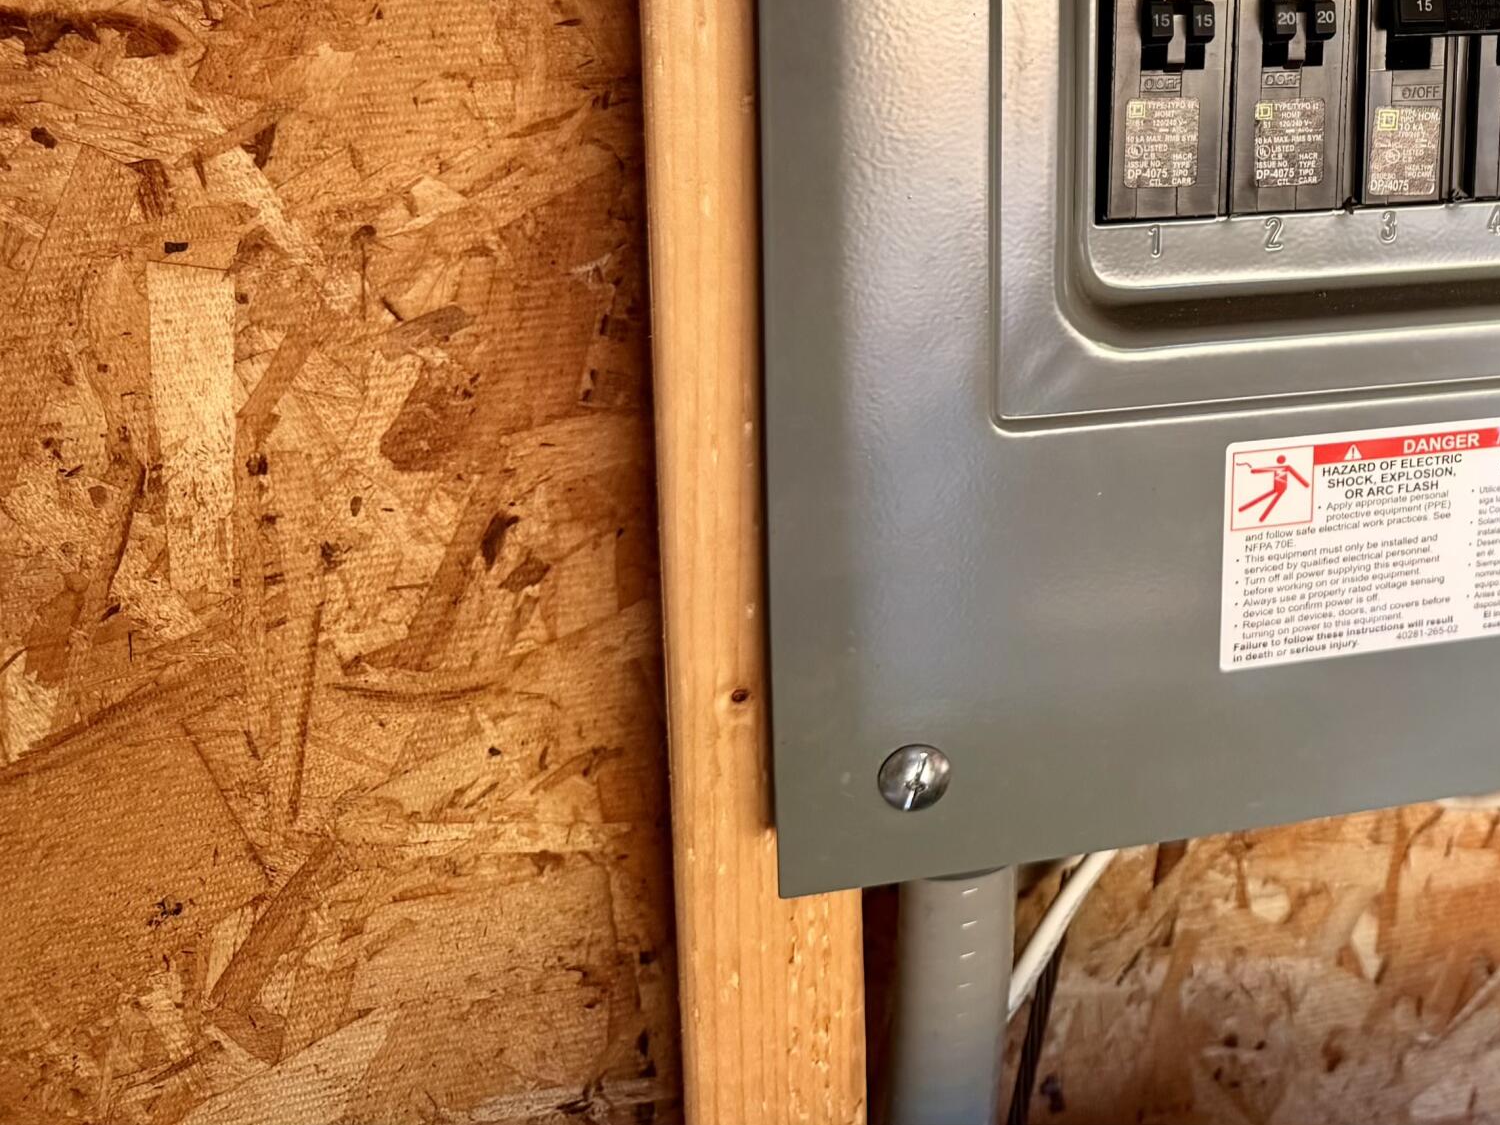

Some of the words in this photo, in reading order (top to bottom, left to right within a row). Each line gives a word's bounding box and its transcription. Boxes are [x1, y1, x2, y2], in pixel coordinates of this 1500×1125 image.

[1417, 0, 1433, 11] 15
[1152, 14, 1170, 27] 15
[1195, 14, 1213, 27] 15
[1278, 12, 1295, 25] 20
[1317, 10, 1334, 24] 20
[1128, 168, 1168, 179] DP-4075
[1256, 168, 1294, 179] DP-4075
[1264, 216, 1284, 252] 2
[1379, 210, 1398, 244] 3
[1148, 223, 1161, 259] 1
[1403, 432, 1480, 453] DANGER
[1322, 461, 1376, 477] HAZARD
[1379, 460, 1396, 471] OF
[1400, 453, 1462, 469] ELECTRIC
[1344, 487, 1364, 499] OR
[1367, 484, 1393, 497] ARC
[1397, 480, 1439, 493] FLASH
